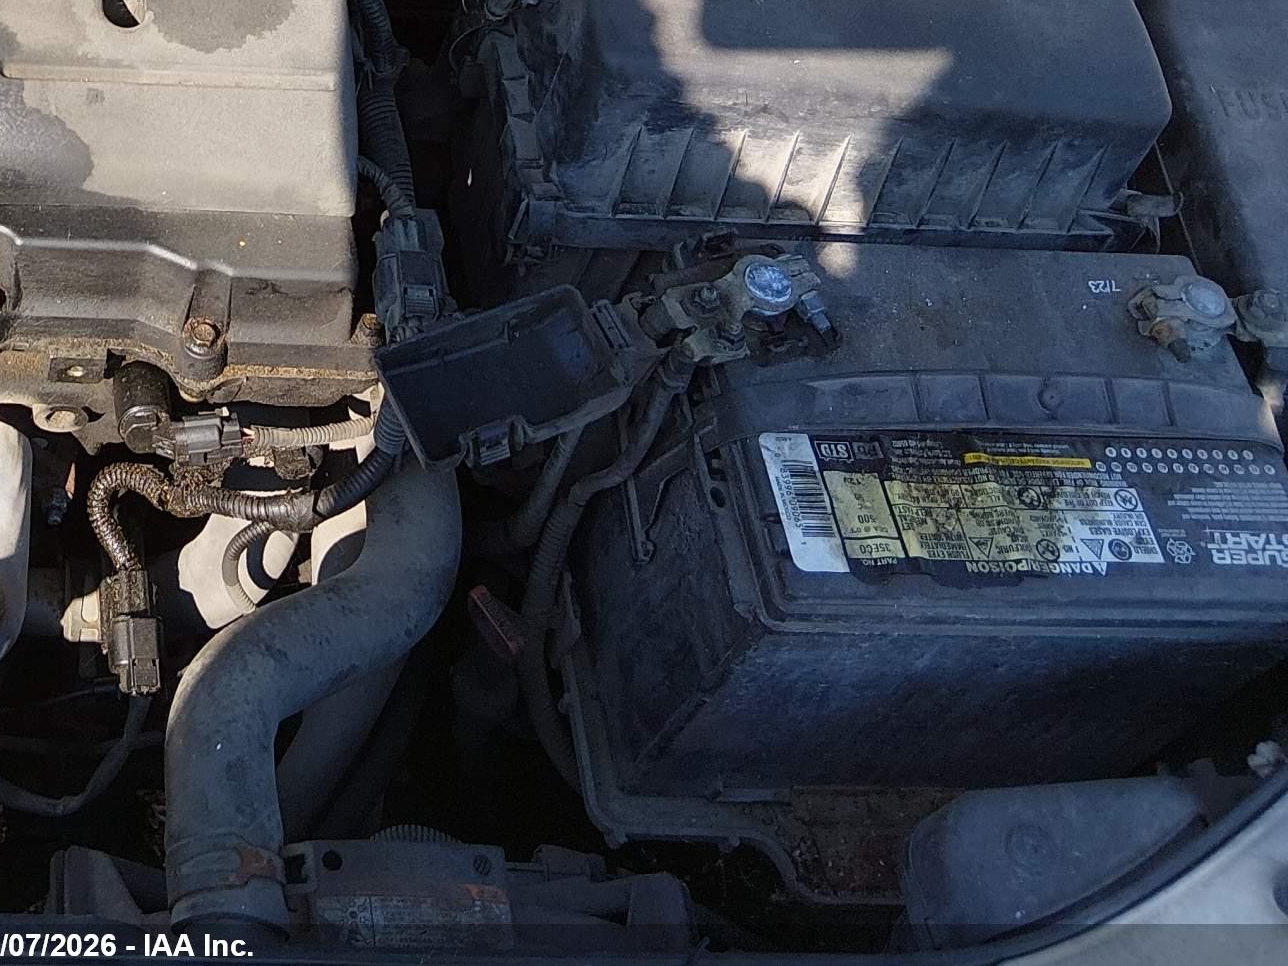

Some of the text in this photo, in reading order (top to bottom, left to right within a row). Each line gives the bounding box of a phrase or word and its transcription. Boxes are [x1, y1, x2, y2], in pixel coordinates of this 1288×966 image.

[820, 442, 848, 458] STD
[857, 513, 875, 523] 500
[859, 542, 890, 554] 35ECO
[861, 555, 898, 566] PART NO.
[966, 560, 1093, 574] DANGER/POISON
